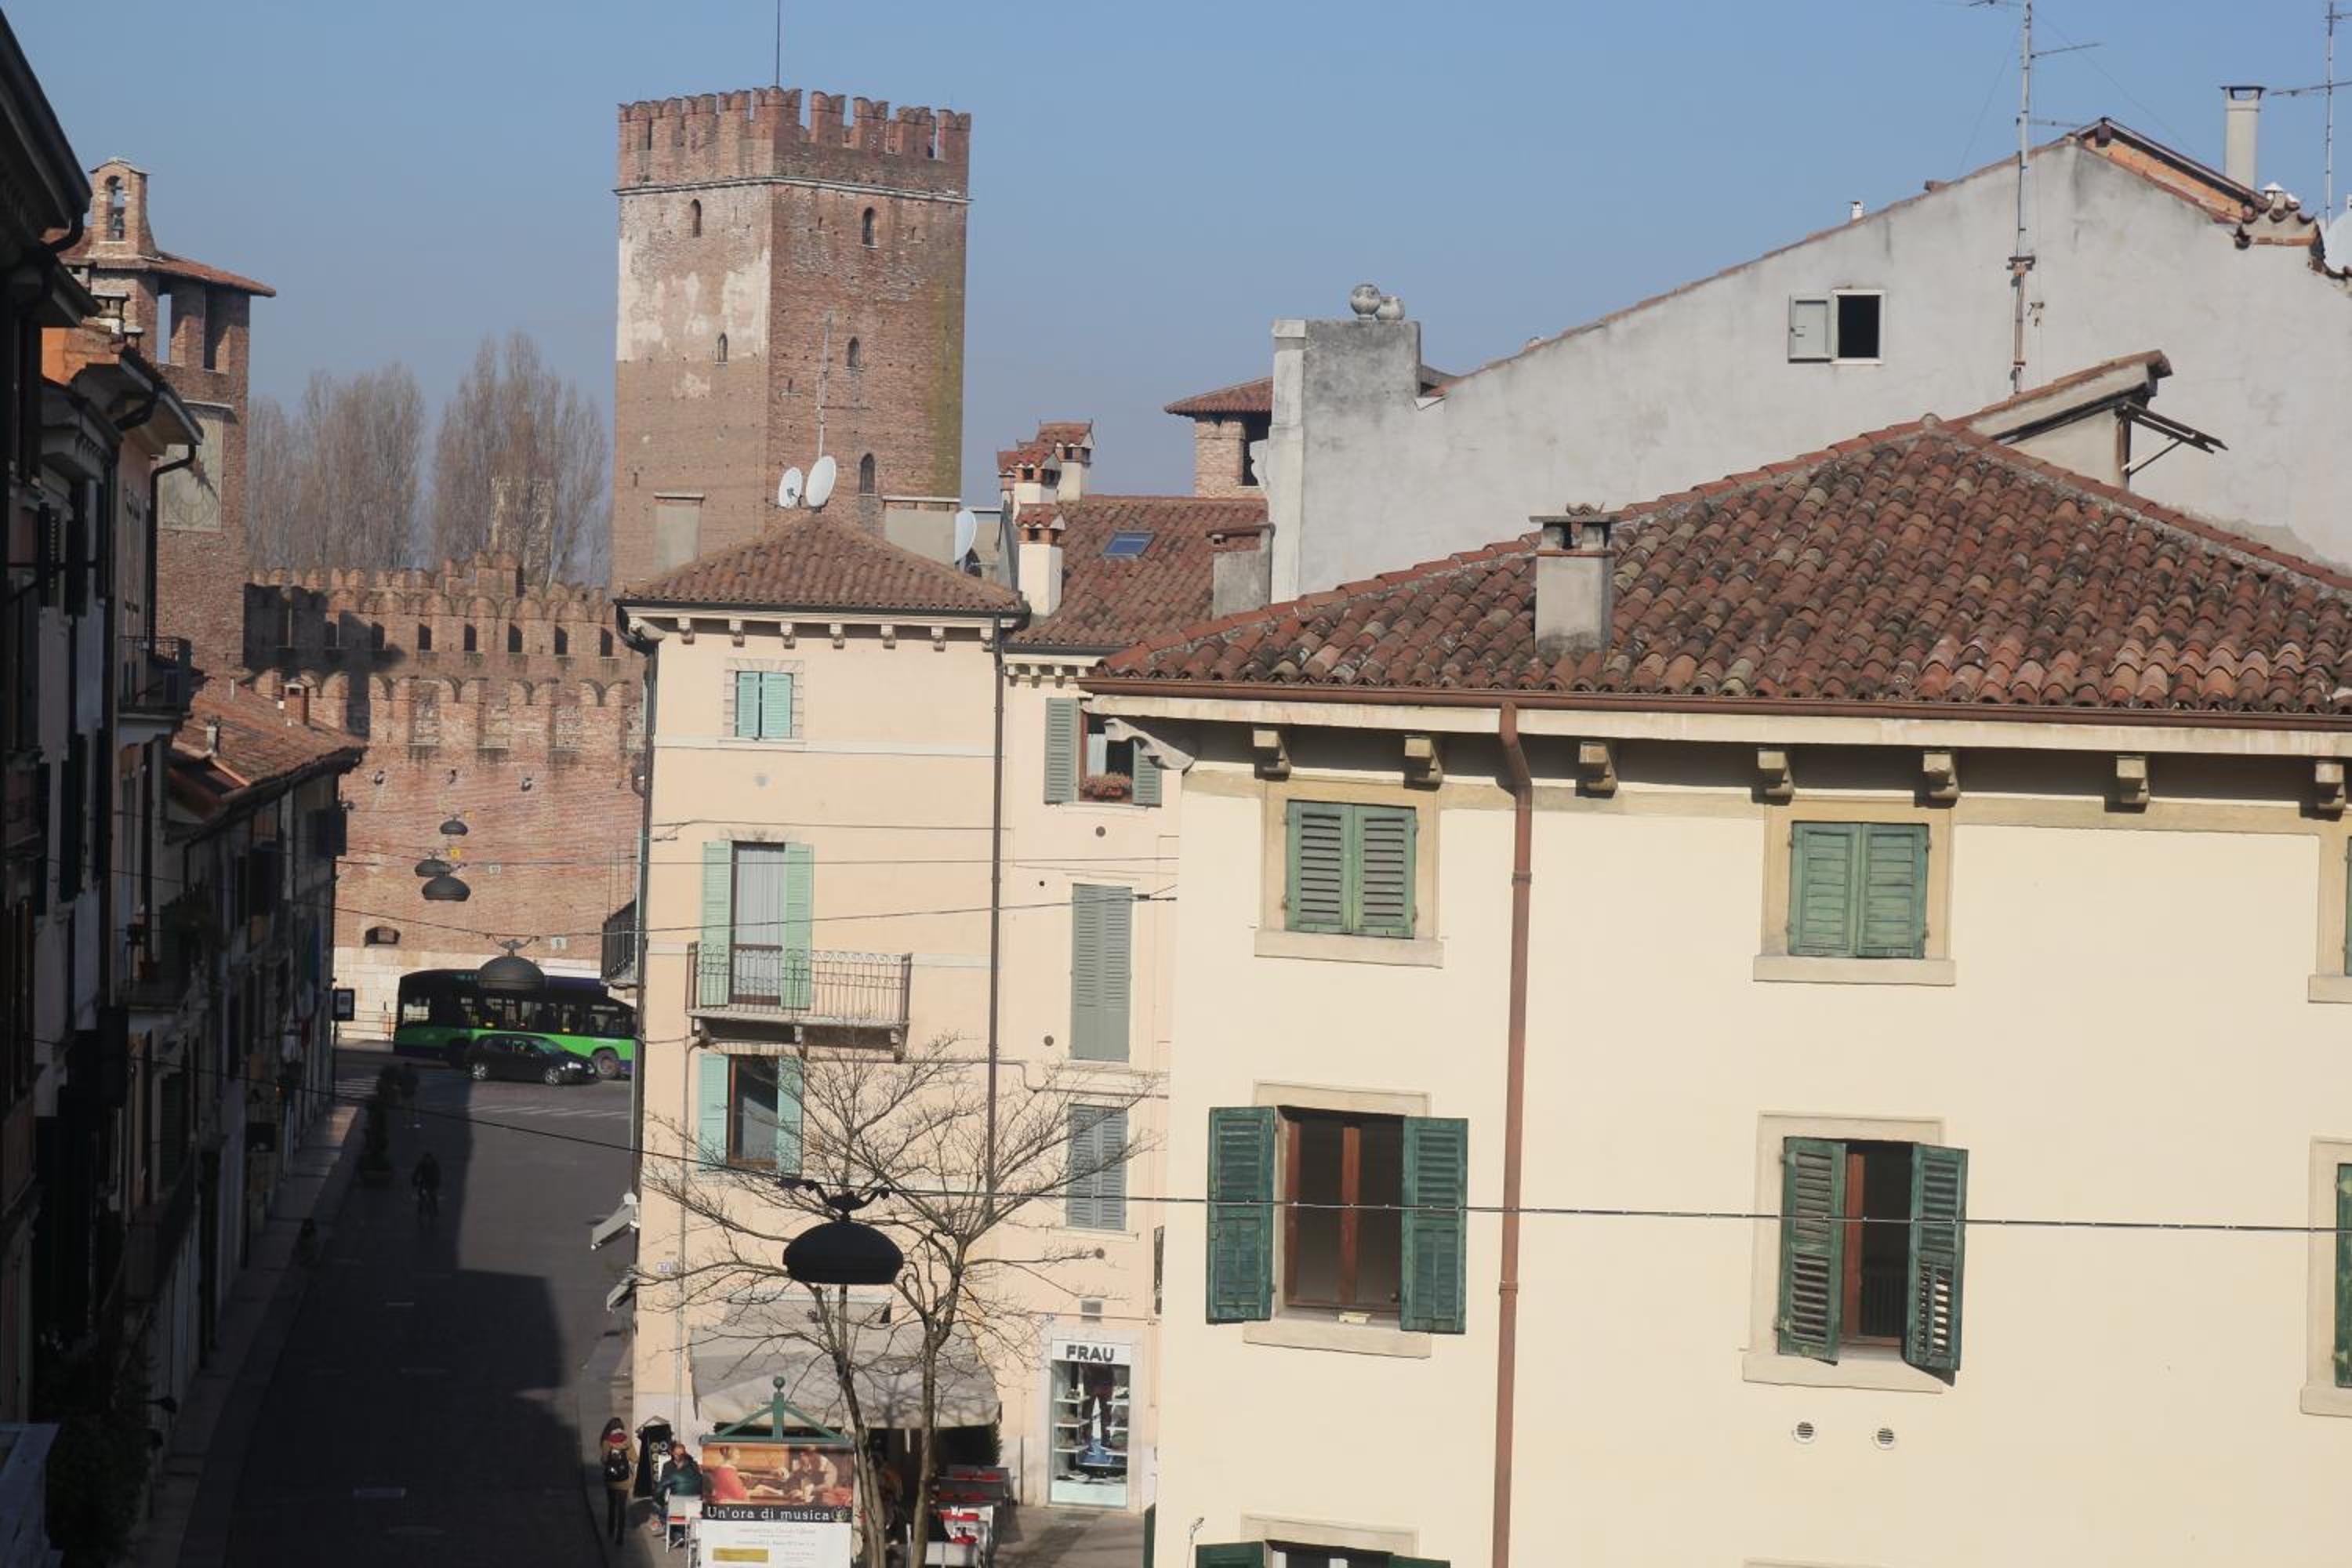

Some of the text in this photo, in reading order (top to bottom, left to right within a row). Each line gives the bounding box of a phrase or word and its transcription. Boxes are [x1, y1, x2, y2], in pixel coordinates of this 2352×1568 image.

[1066, 1345, 1114, 1362] FRAU
[707, 1506, 830, 1520] Un'ora di musica
